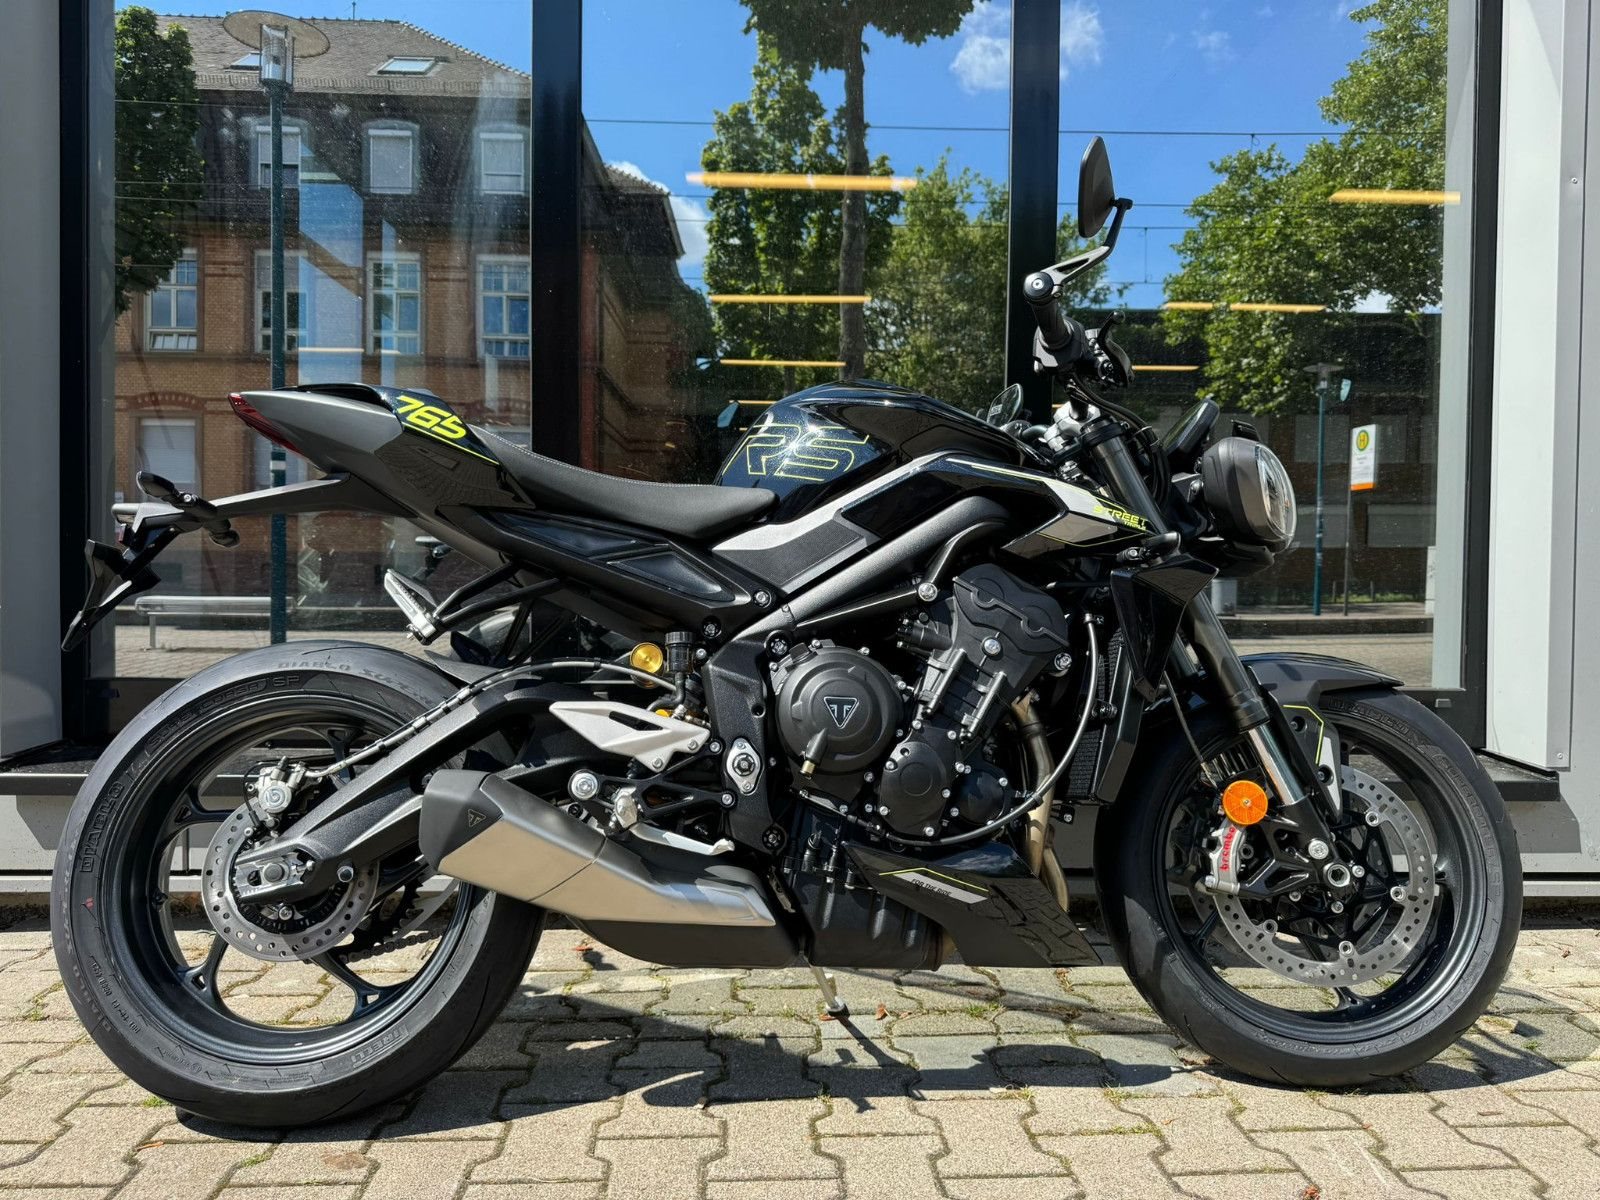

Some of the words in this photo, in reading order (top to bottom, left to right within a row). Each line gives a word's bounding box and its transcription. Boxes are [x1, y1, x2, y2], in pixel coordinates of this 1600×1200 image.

[397, 395, 467, 439] 765
[722, 423, 870, 482] RS
[1094, 505, 1149, 526] STREET
[273, 675, 300, 688] SP
[79, 780, 125, 874] DIABLO
[1219, 826, 1237, 872] brembo
[911, 879, 924, 887] FOR
[351, 1024, 409, 1068] PIRELLI
